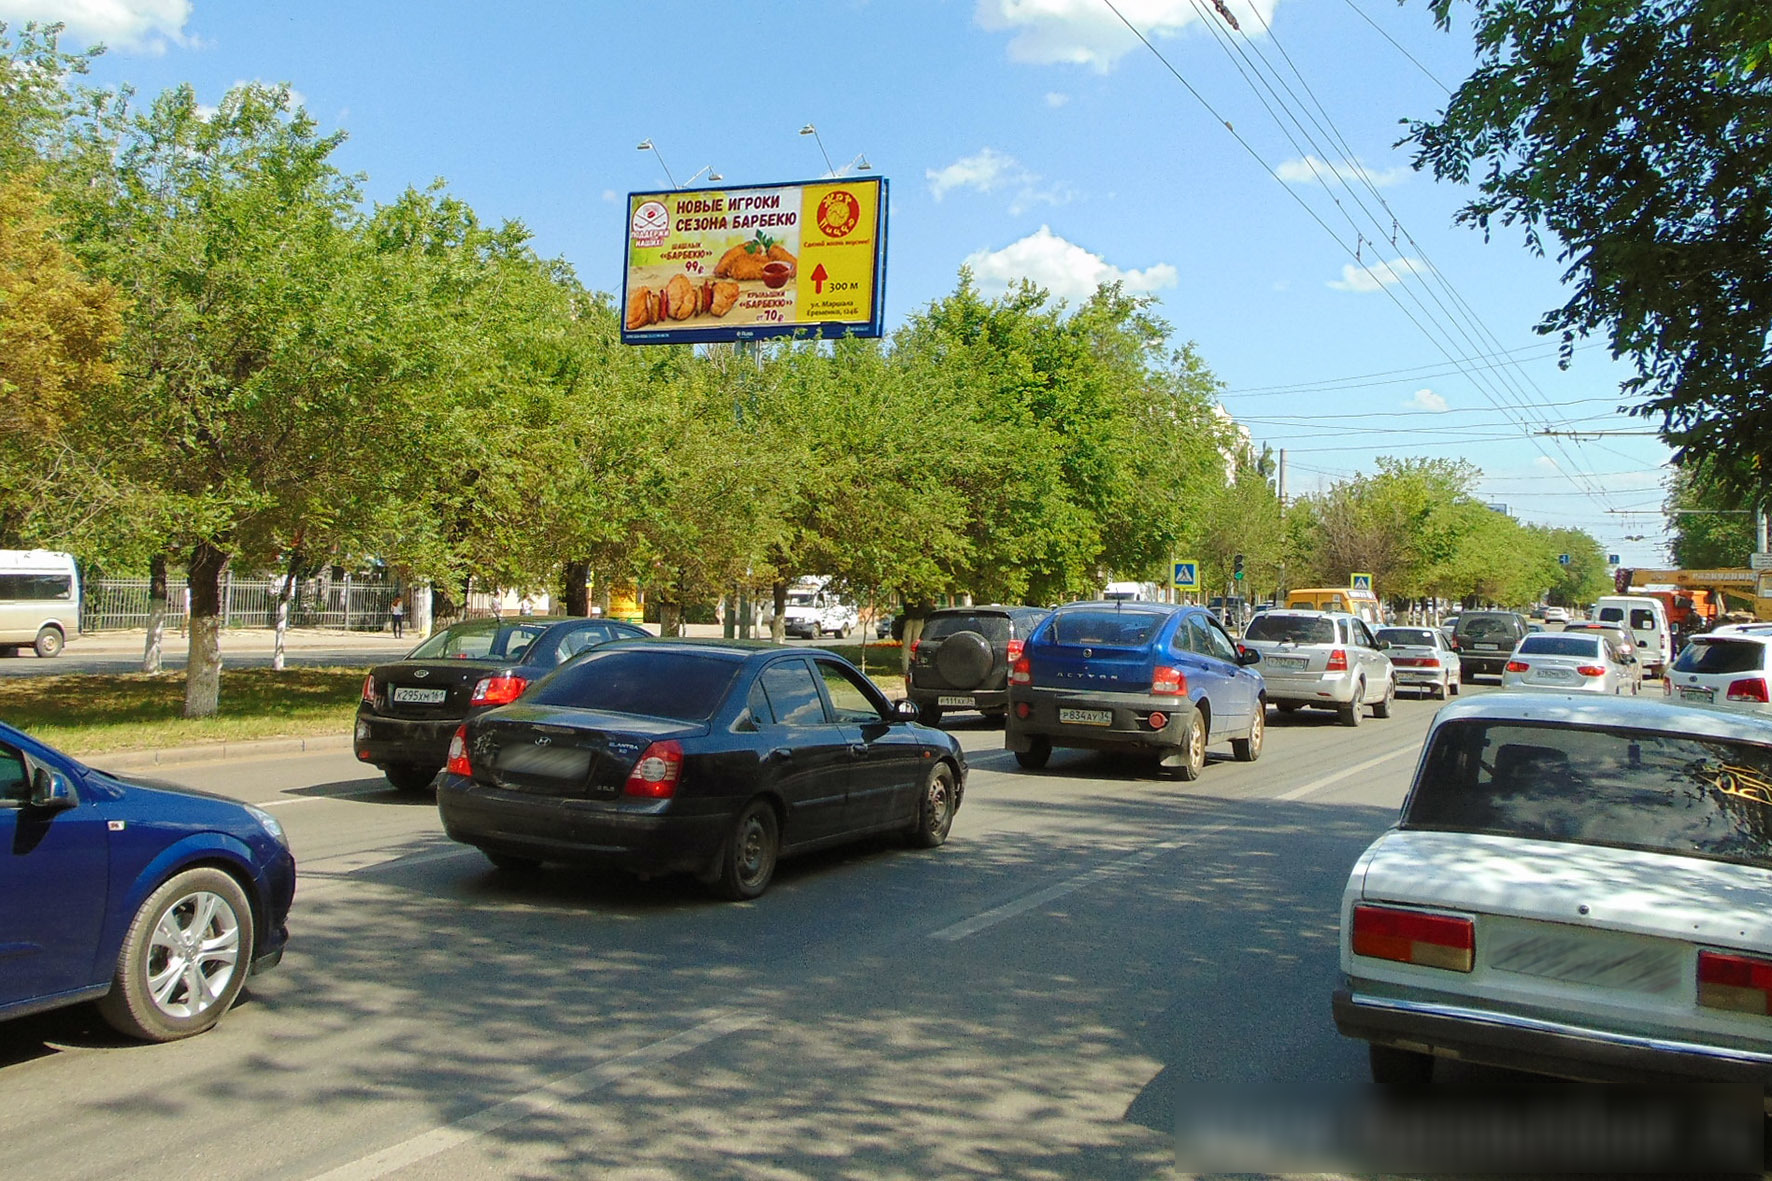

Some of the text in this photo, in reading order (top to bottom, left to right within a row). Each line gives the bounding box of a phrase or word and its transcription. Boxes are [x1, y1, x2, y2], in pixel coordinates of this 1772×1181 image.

[676, 195, 780, 214] НОВЫЕ ИГРОКИ
[676, 212, 797, 232] СЕЗОНА БАРБЕКЮ
[830, 282, 848, 292] 300
[608, 742, 638, 750] ELANTRA
